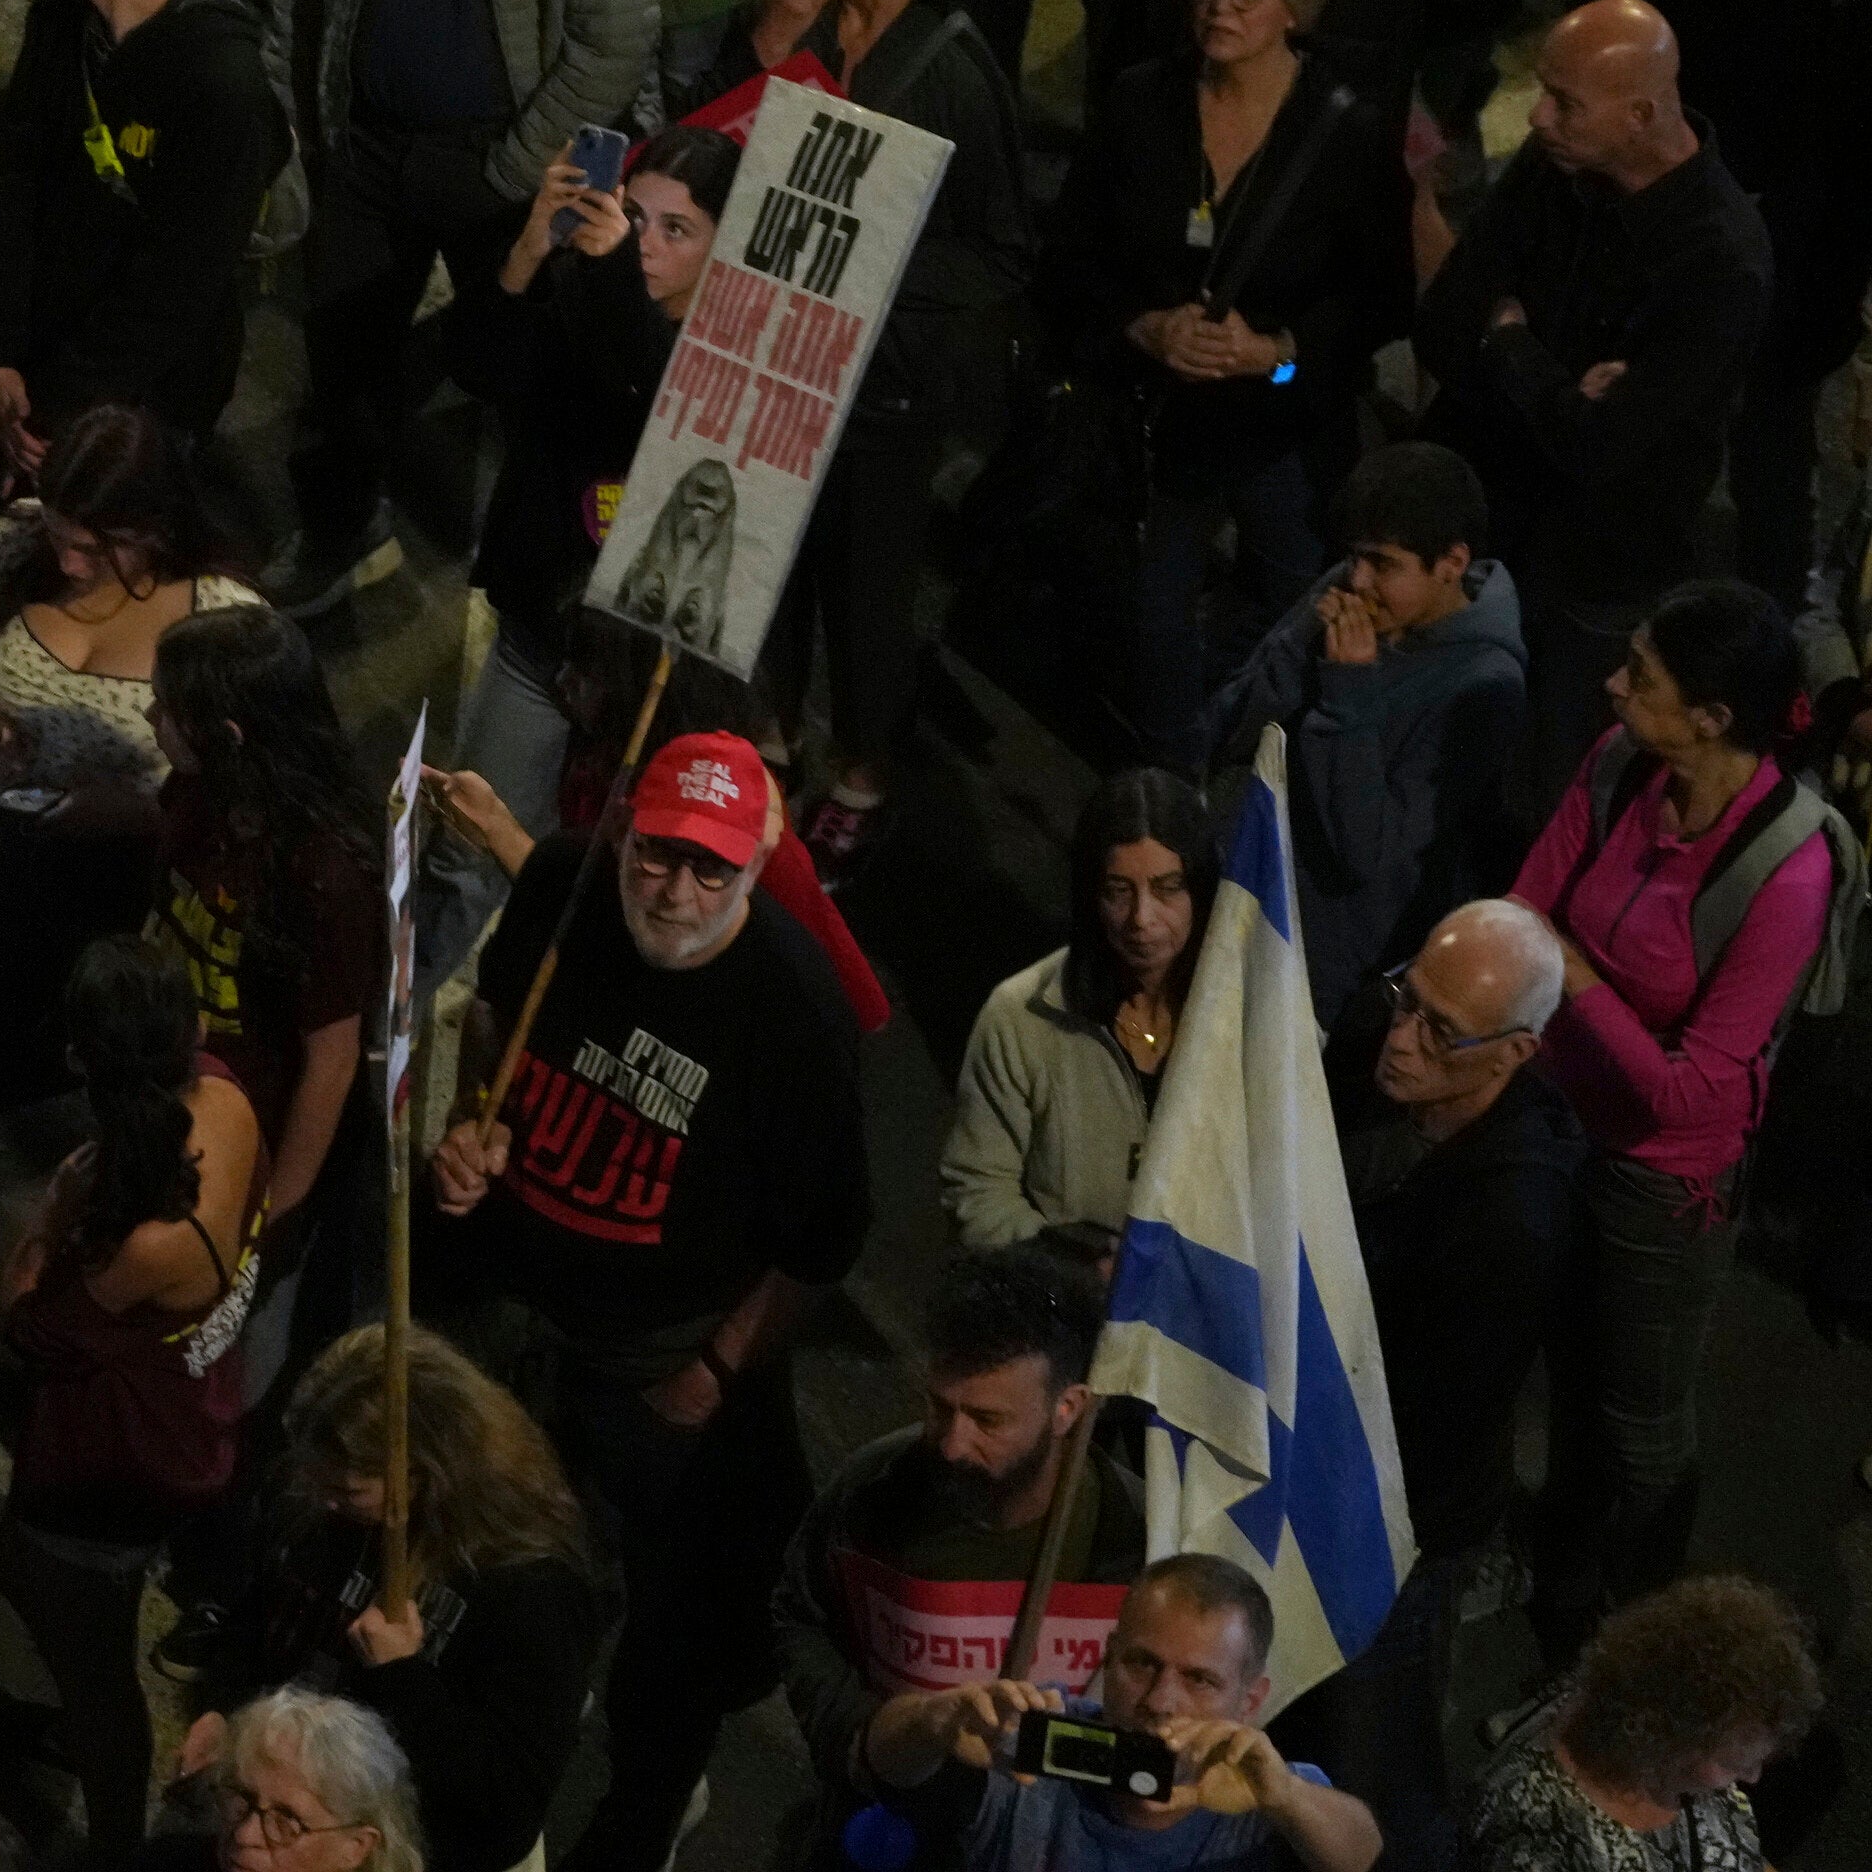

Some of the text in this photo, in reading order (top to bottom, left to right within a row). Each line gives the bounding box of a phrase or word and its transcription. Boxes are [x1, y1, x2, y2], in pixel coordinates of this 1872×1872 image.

[743, 185, 862, 300] הראש
[766, 290, 865, 398] אתה
[1052, 1637, 1101, 1671] מי
